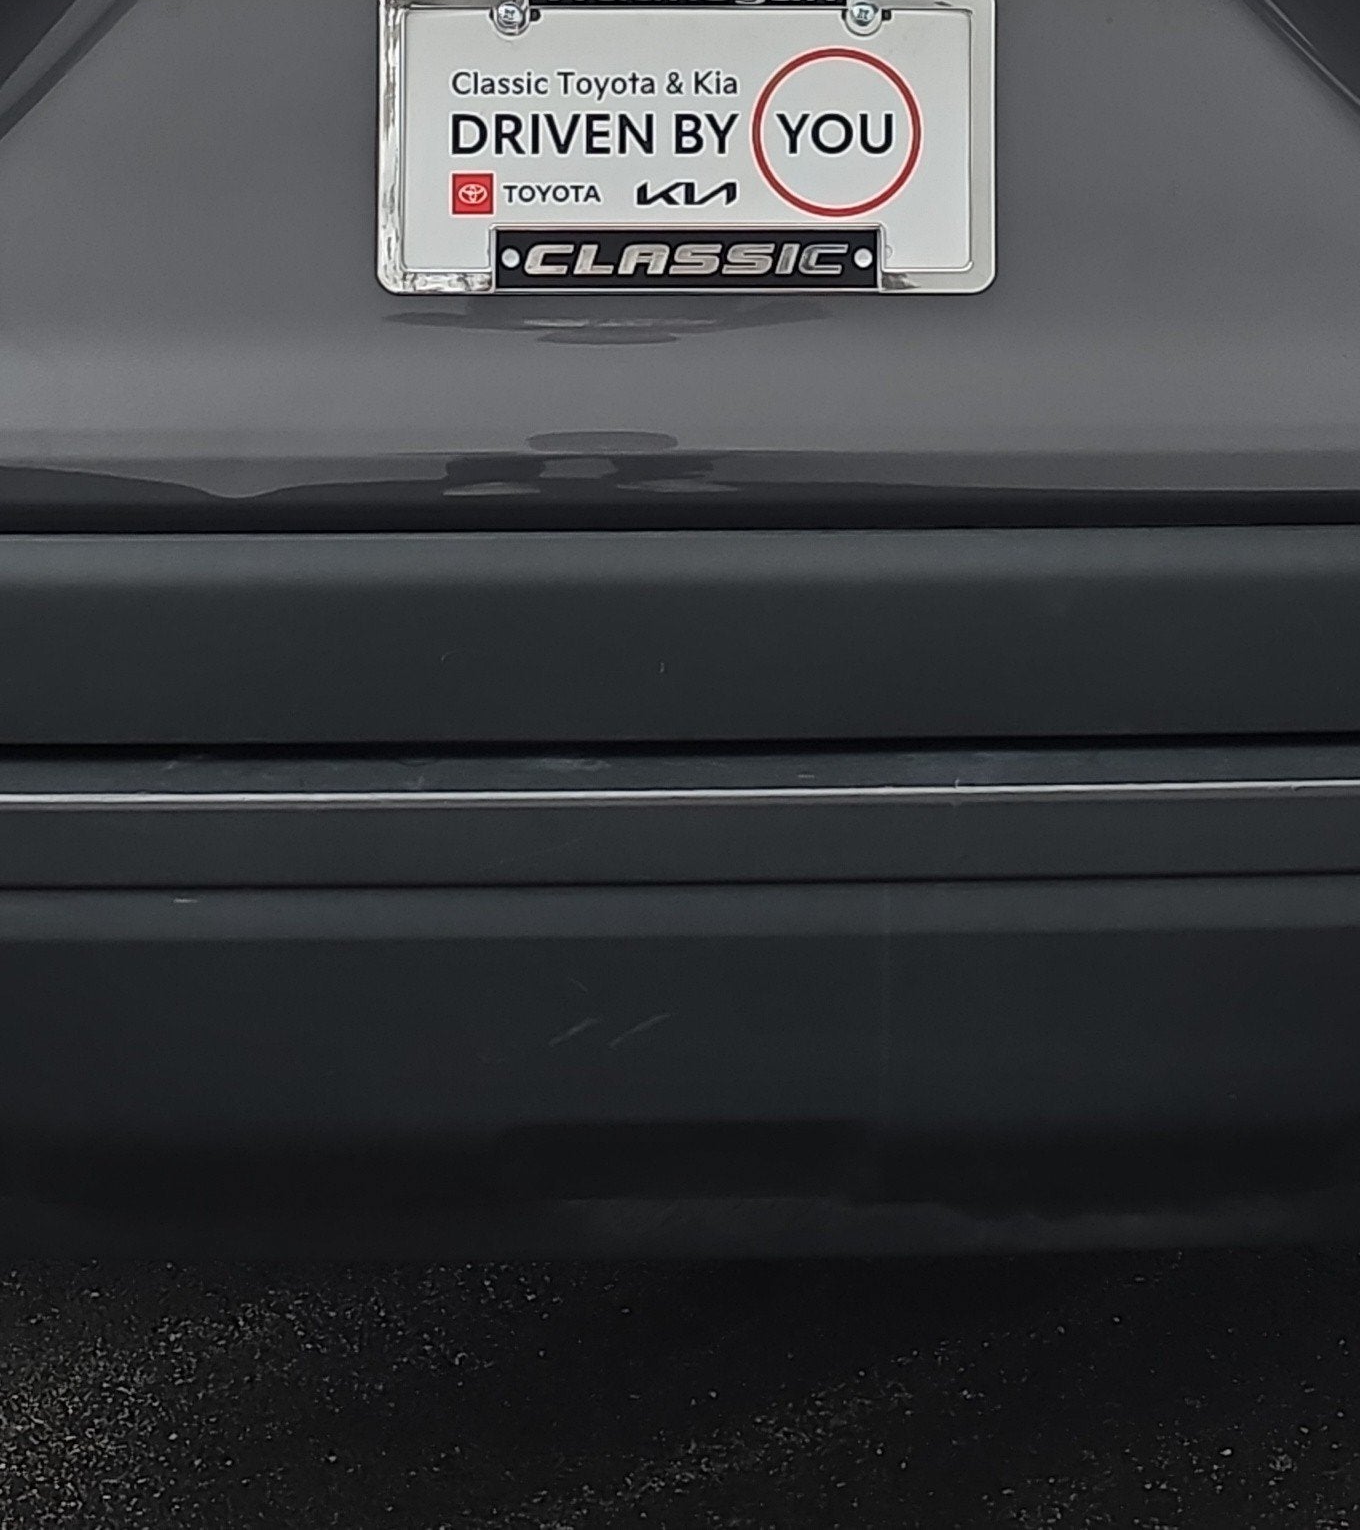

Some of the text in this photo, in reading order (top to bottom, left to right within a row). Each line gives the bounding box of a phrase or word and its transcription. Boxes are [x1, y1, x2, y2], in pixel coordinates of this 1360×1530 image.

[451, 70, 738, 100] Classic Toyota & Kia
[451, 113, 895, 155] DRIVEN BY YOU
[503, 185, 601, 203] TOYOTA
[524, 244, 848, 275] CLASSIC
